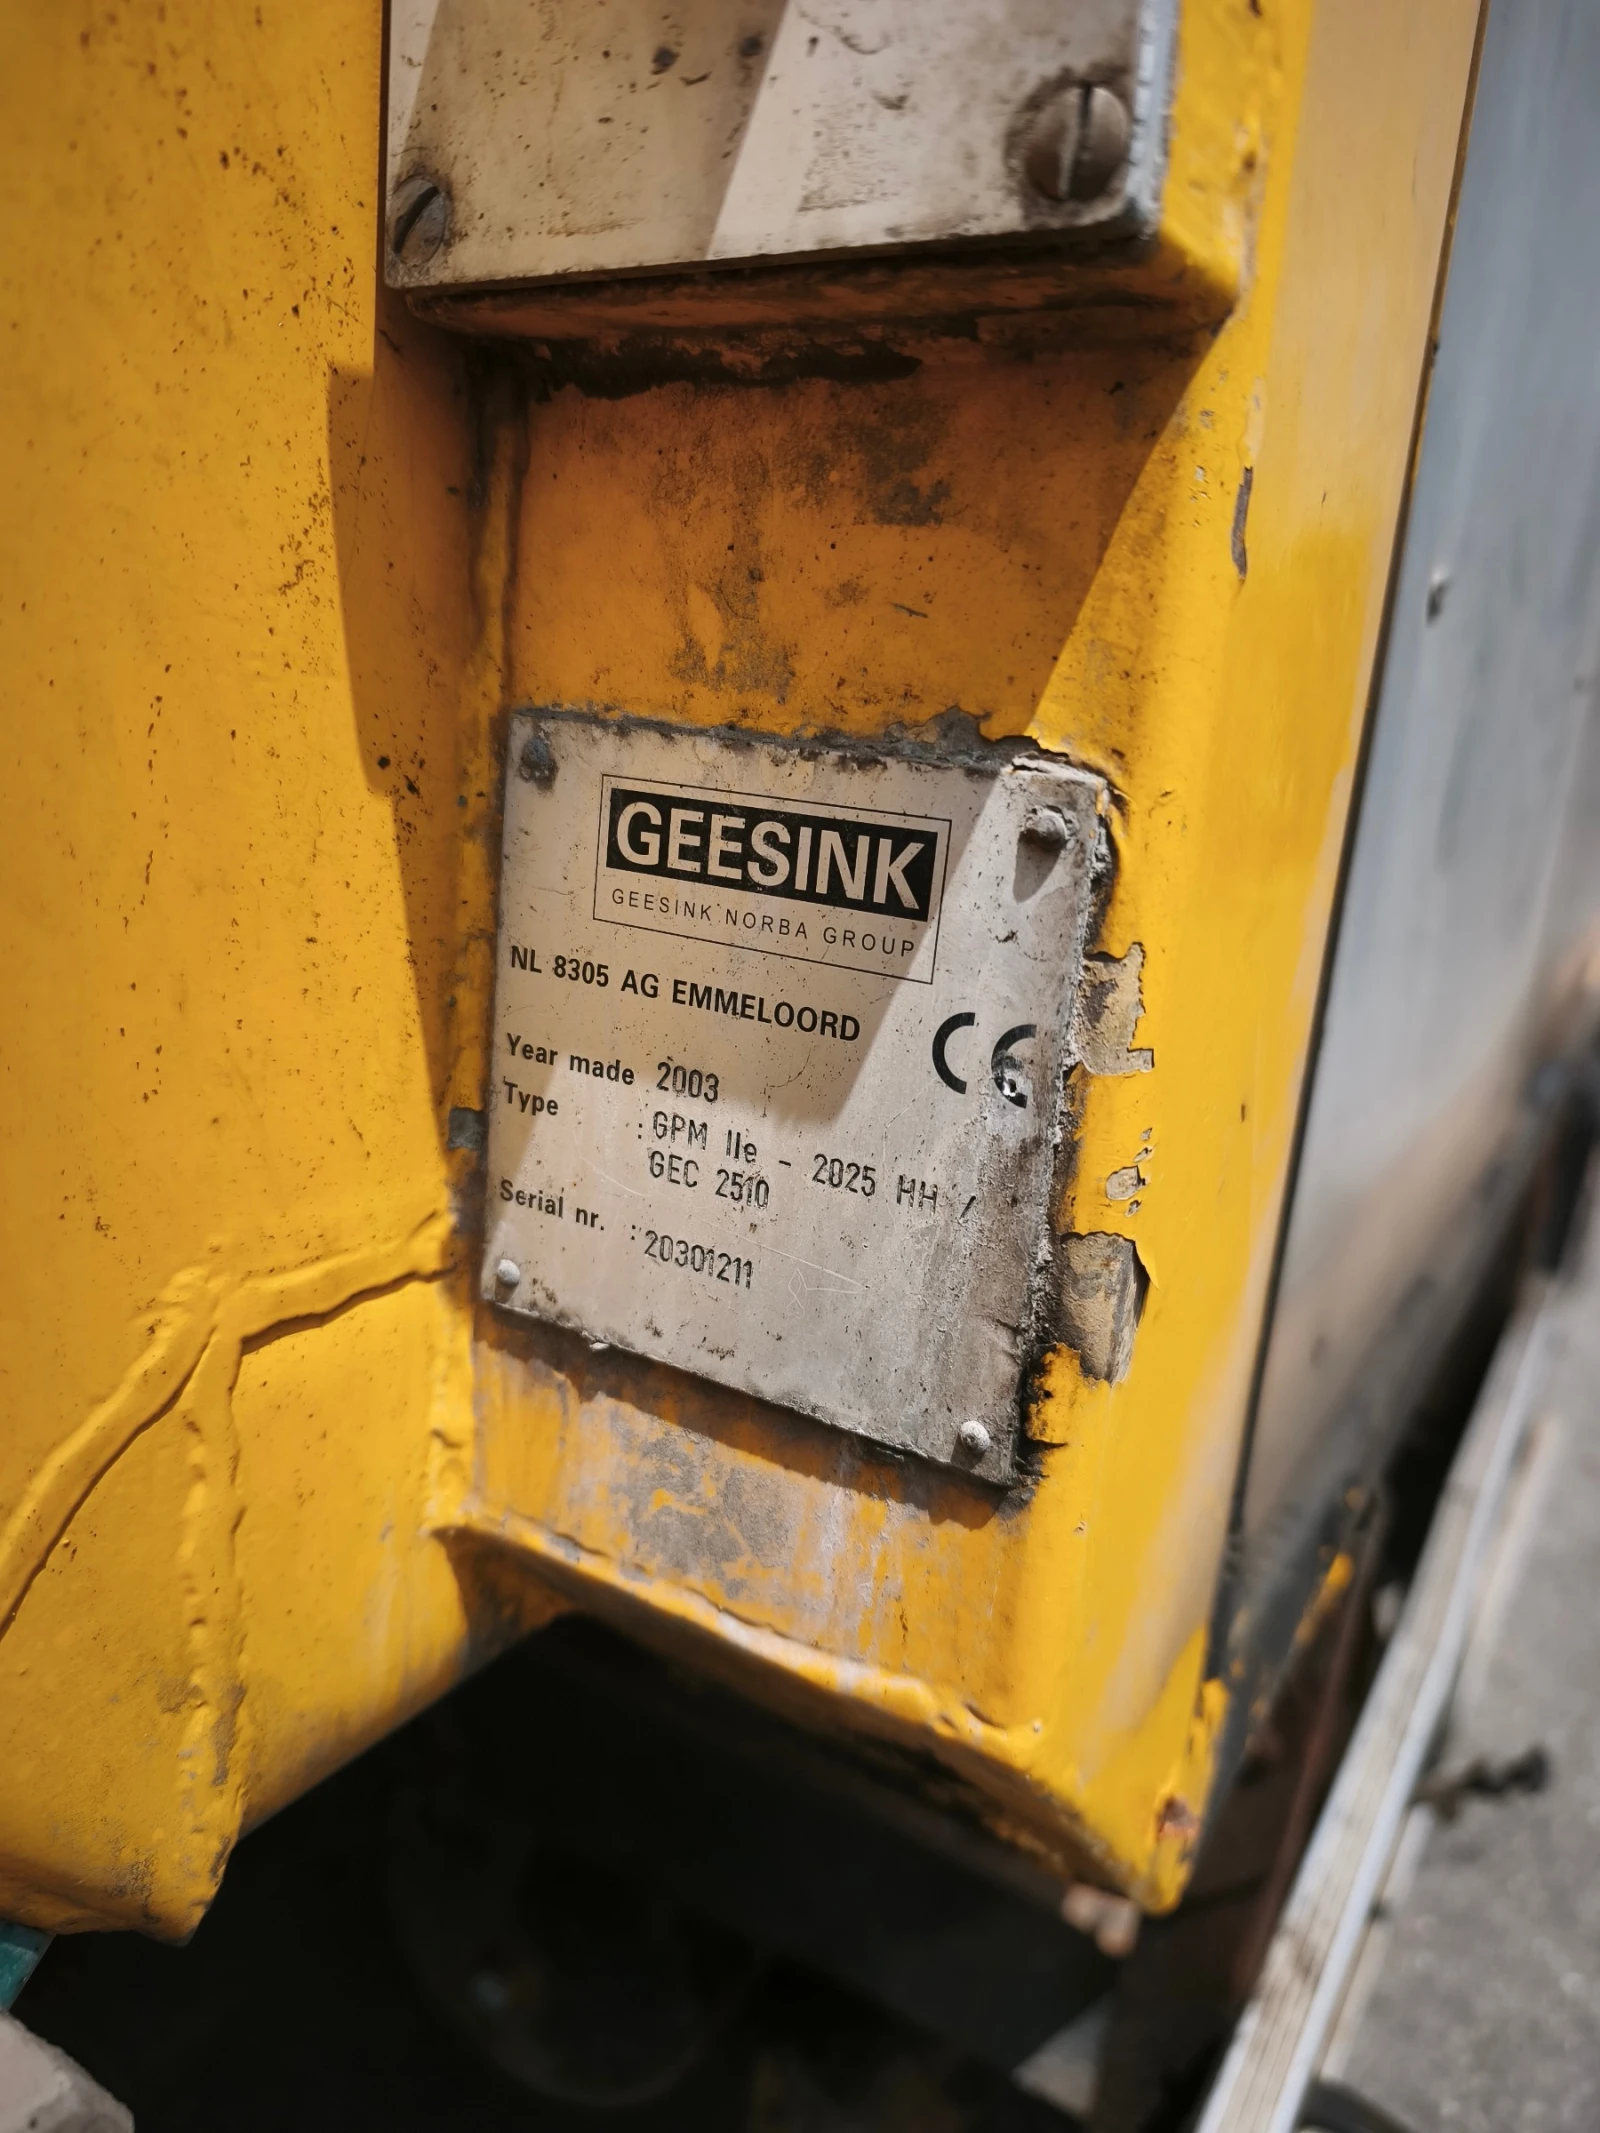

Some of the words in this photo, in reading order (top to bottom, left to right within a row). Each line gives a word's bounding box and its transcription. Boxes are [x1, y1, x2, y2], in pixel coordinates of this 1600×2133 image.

[616, 801, 926, 911] GEESINK
[611, 888, 711, 922] GEESINK
[726, 908, 808, 940] NORBA
[823, 926, 915, 958] GROUP
[510, 945, 543, 974] NL
[553, 955, 610, 988] 8305
[620, 969, 660, 999] AG
[671, 978, 862, 1042] EMMELOORD
[506, 1032, 559, 1066] Year
[569, 1053, 636, 1086] made
[656, 1061, 720, 1103] 2003
[503, 1081, 559, 1117] Type
[811, 1153, 877, 1198] 2025
[649, 1150, 701, 1188] GEC
[715, 1168, 771, 1211] 2510
[500, 1178, 564, 1219] Serial
[575, 1206, 605, 1231] nr.
[643, 1229, 754, 1291] 20301211
